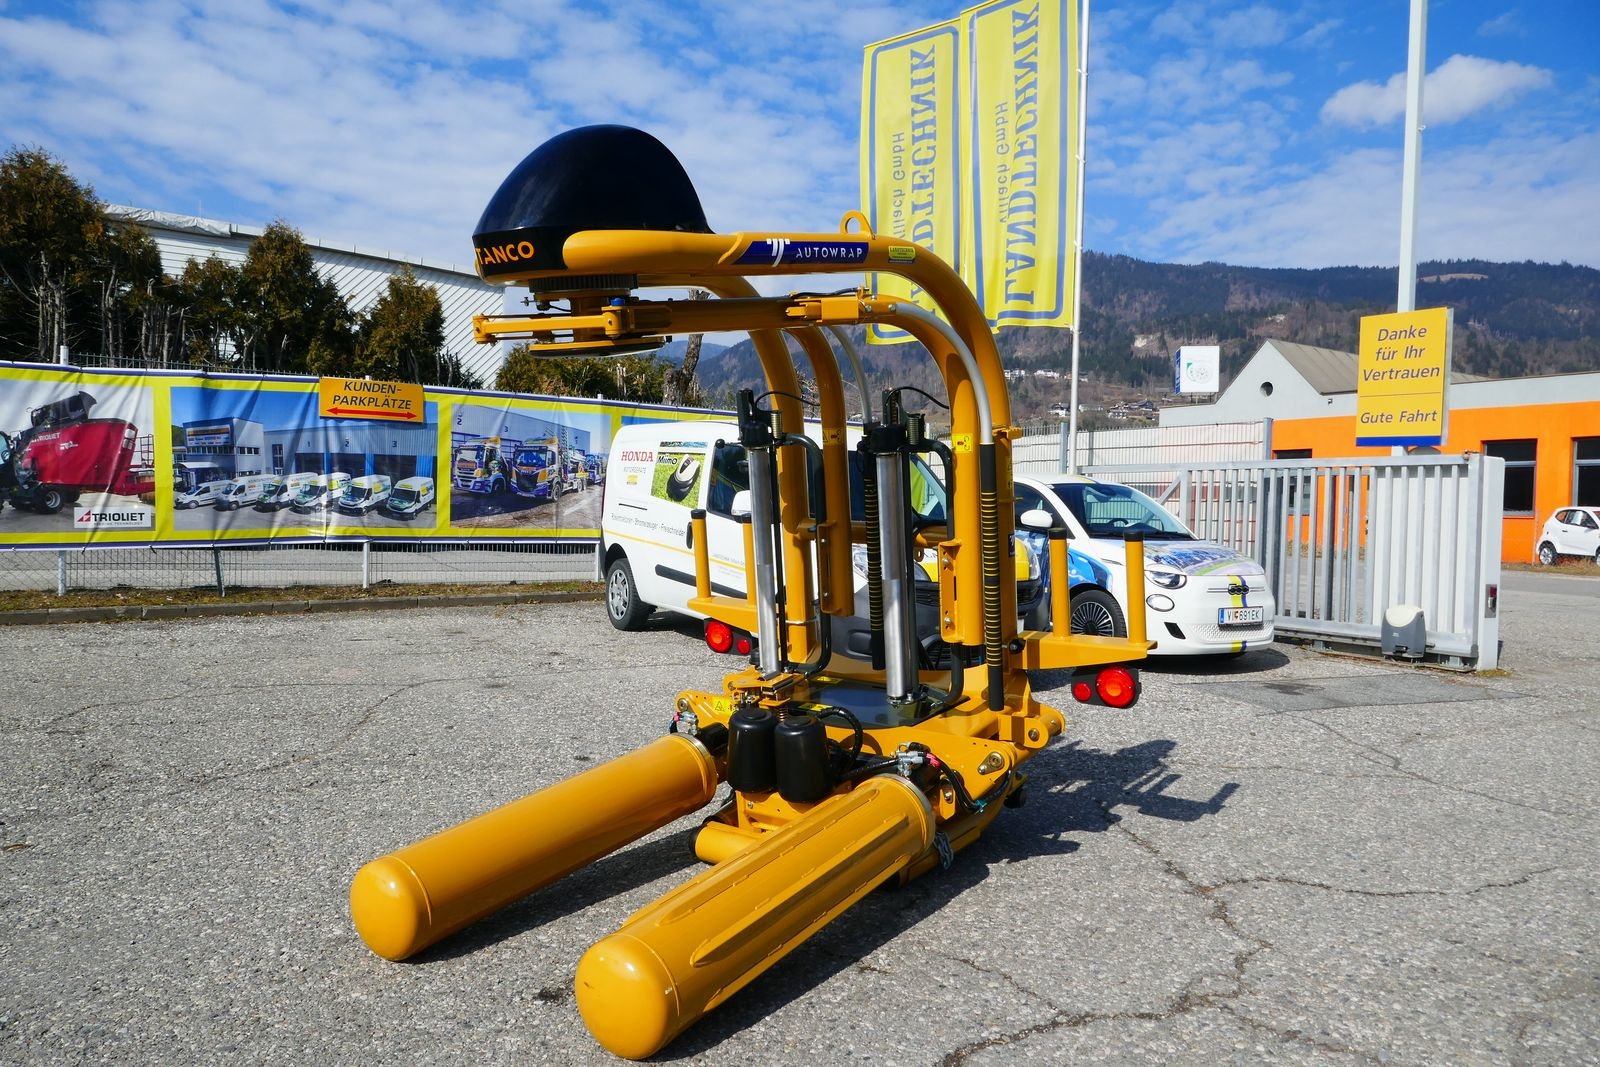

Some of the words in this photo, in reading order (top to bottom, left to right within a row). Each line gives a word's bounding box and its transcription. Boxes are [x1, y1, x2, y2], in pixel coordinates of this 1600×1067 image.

[475, 241, 534, 264] TANCO
[796, 247, 863, 258] AUTOWRAP
[1377, 324, 1427, 342] Danke
[1375, 346, 1398, 361] für
[1404, 345, 1426, 359] Ihr
[1363, 366, 1440, 381] Vertrauen
[344, 381, 402, 394] KUNDEN-
[333, 394, 412, 410] PARKPLÄTZE
[1360, 411, 1393, 424] Gute
[1399, 409, 1437, 423] Fahrt
[621, 450, 654, 463] HONDA
[92, 512, 145, 522] TRIOLIET
